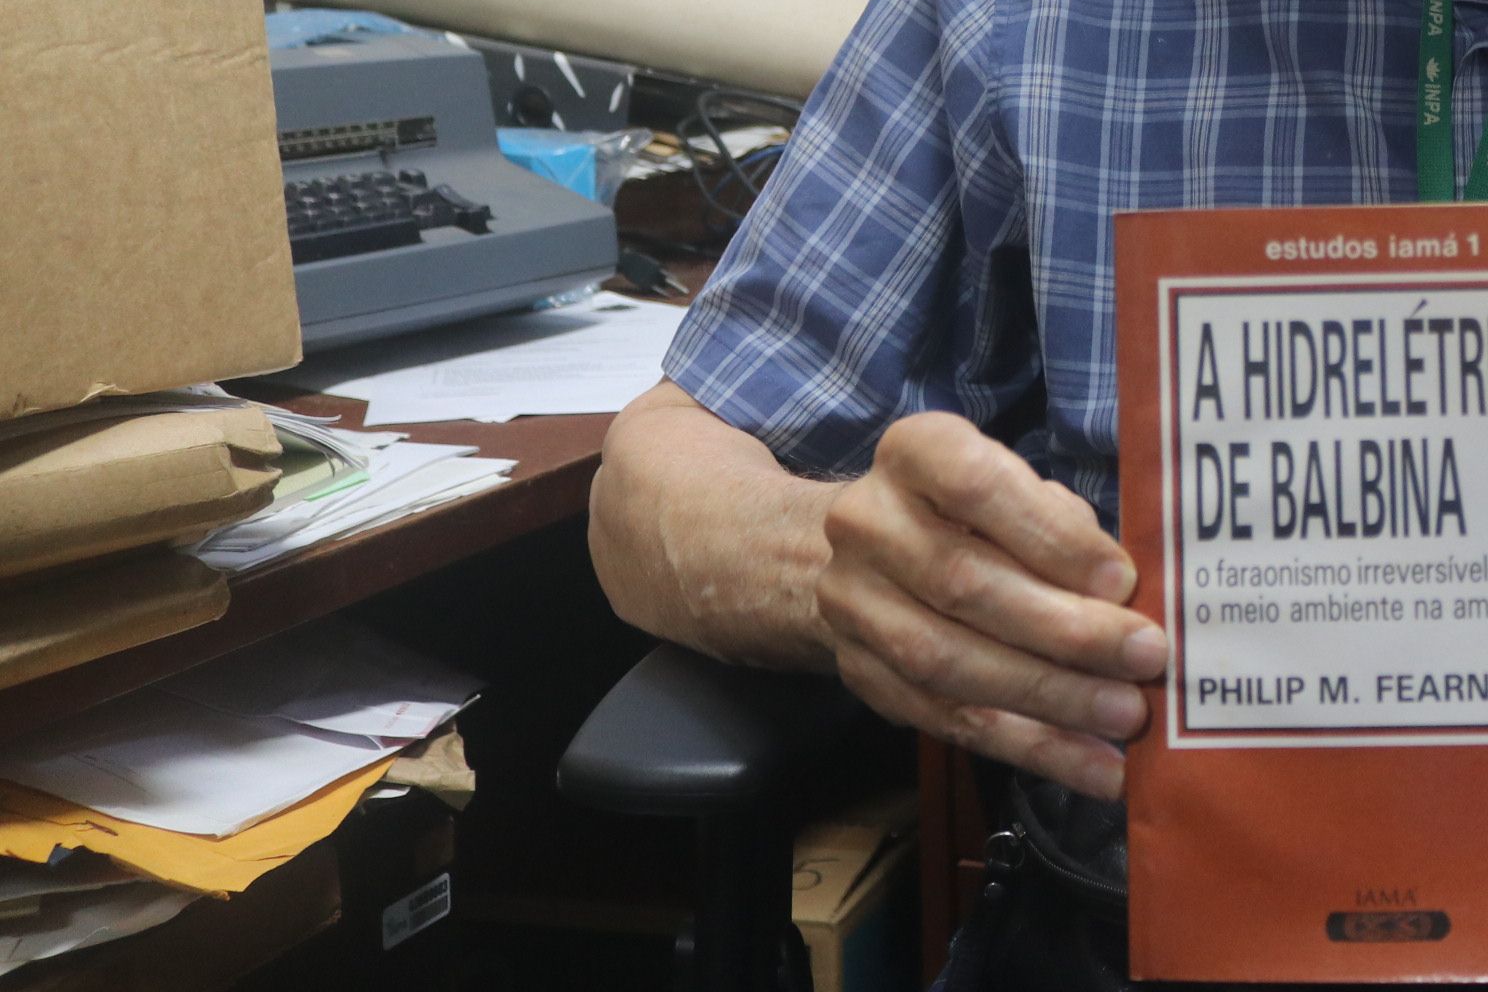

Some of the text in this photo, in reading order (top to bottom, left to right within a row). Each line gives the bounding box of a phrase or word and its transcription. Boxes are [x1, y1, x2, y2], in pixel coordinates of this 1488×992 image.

[1424, 83, 1441, 126] INPA
[1264, 233, 1480, 261] estudos iamá 1
[1192, 322, 1225, 421] A
[1195, 437, 1467, 542] DE BALBINA
[1195, 567, 1210, 588] o
[1216, 558, 1352, 588] faraonismo
[1357, 554, 1488, 586] irreversível
[1195, 602, 1211, 624] o
[1221, 596, 1280, 624] meio
[1289, 594, 1404, 623] ambiente
[1414, 599, 1443, 621] na
[1197, 676, 1305, 706] PHILIP
[1319, 675, 1360, 705] M.
